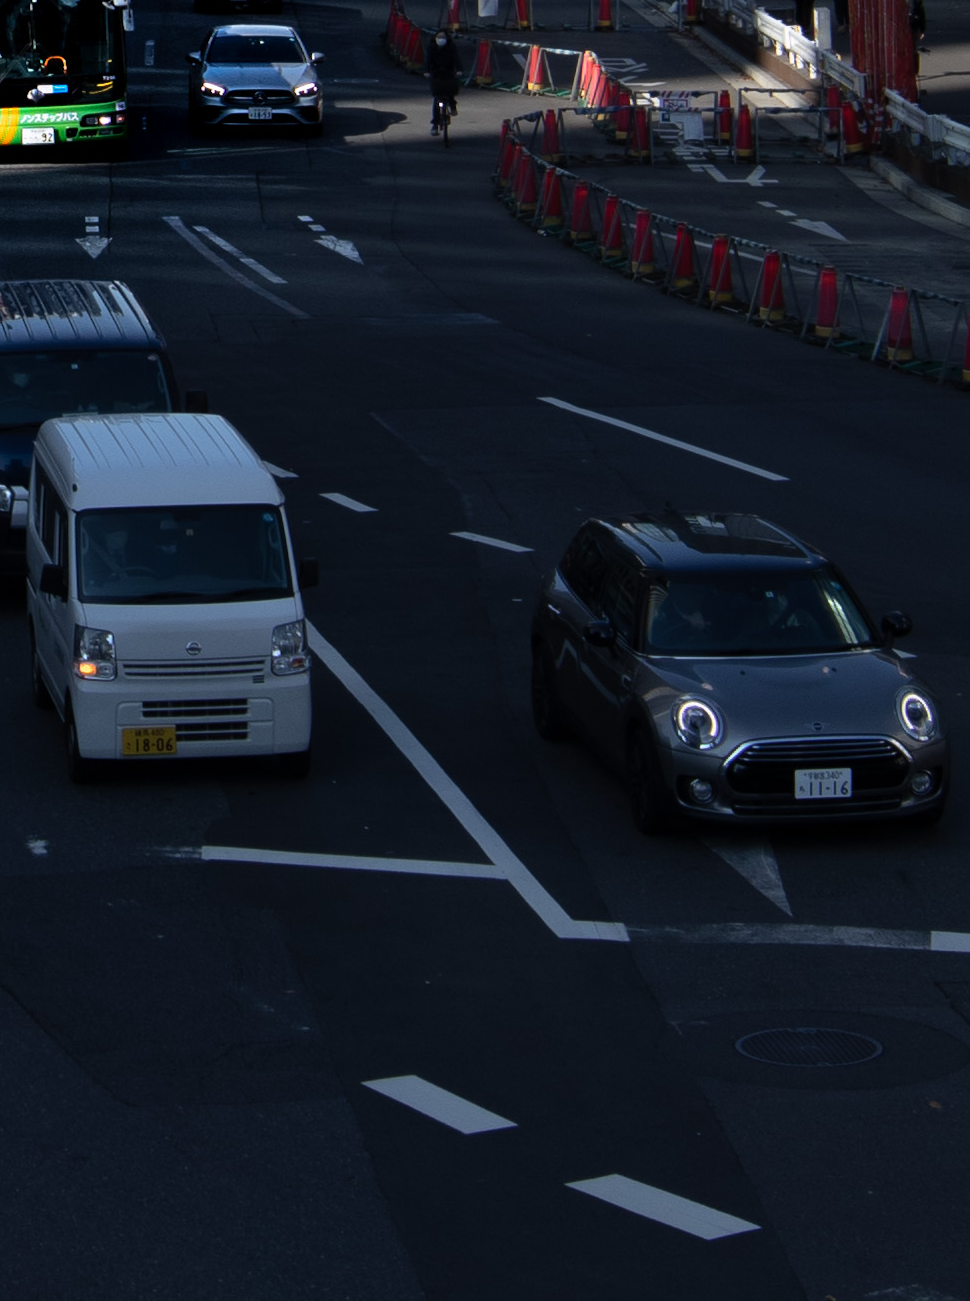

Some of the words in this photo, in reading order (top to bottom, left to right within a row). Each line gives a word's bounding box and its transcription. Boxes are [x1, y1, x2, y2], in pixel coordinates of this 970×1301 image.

[20, 111, 79, 124] ノンステップバス
[135, 737, 174, 752] 18-06
[809, 780, 849, 796] 11-16
